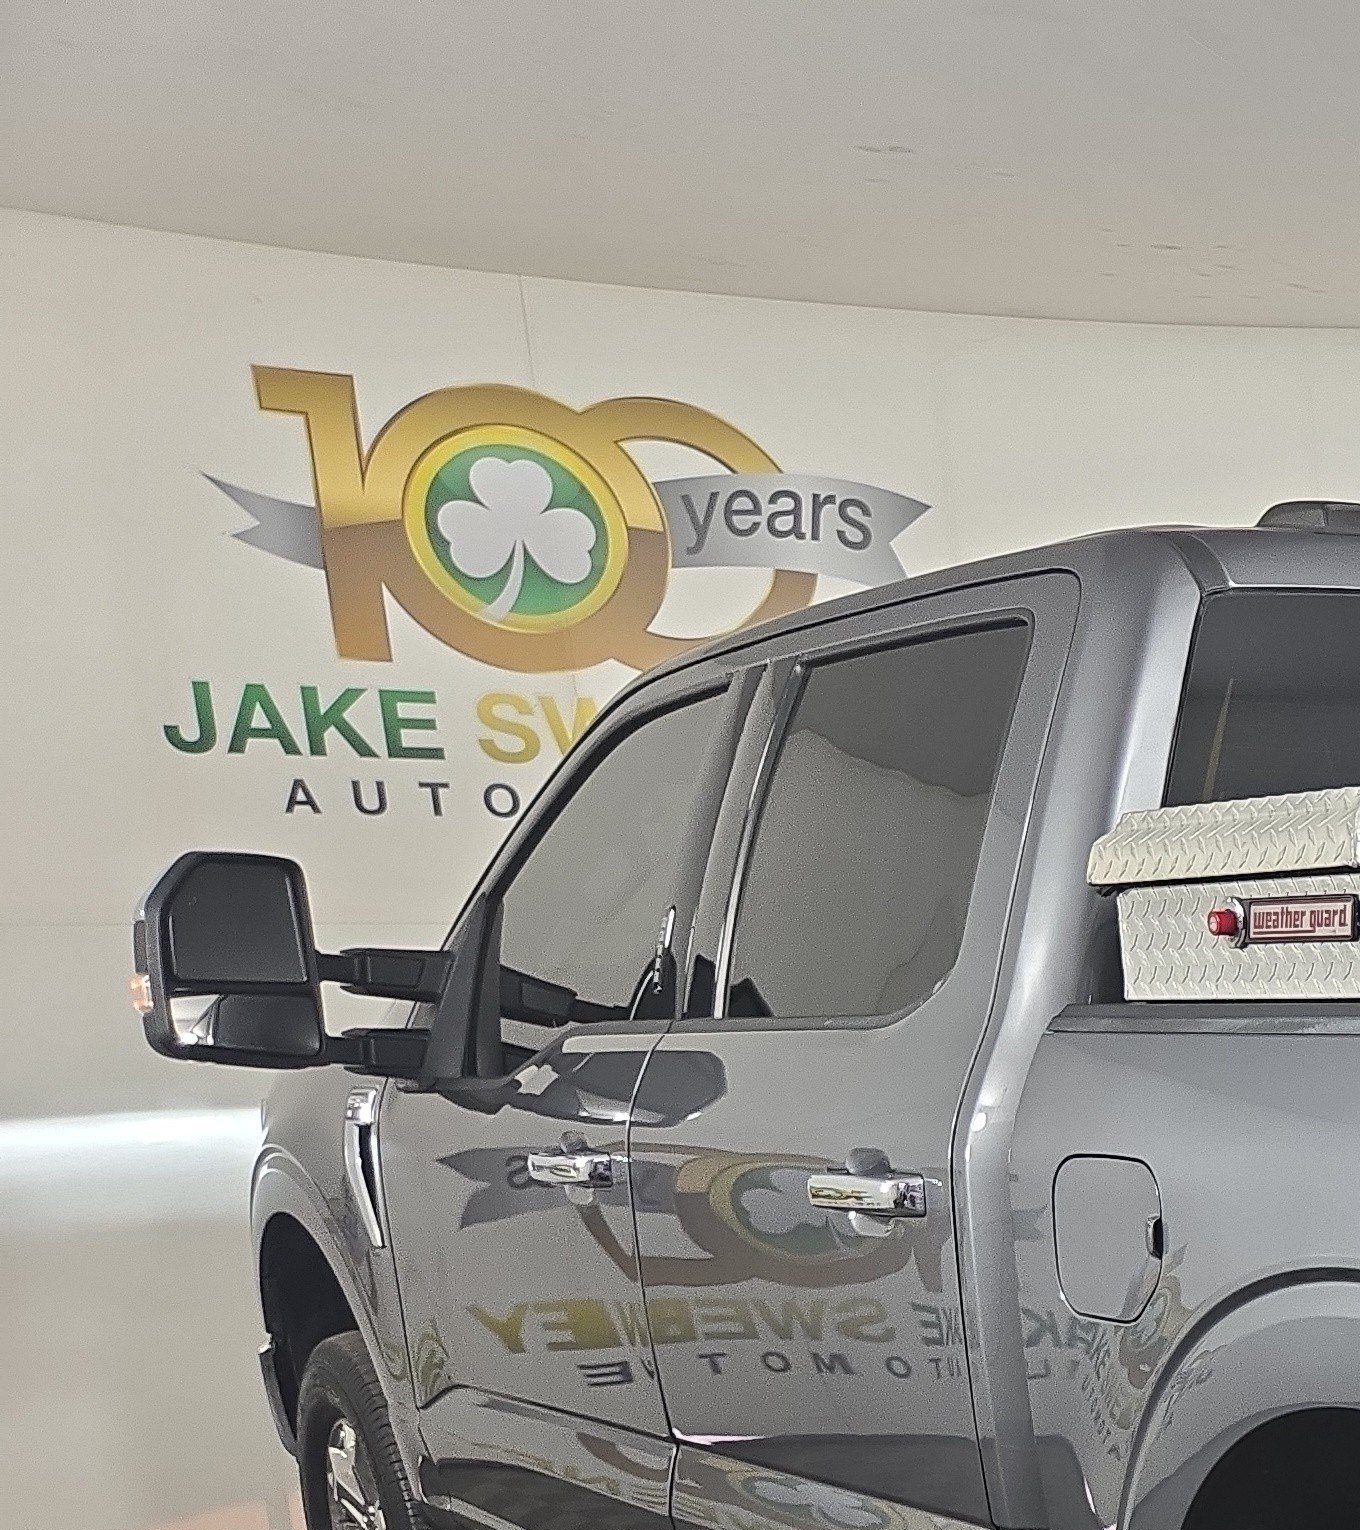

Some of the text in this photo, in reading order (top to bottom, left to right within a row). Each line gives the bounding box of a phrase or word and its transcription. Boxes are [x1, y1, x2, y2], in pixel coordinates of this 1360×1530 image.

[250, 364, 818, 674] 100
[681, 485, 875, 553] years
[162, 680, 447, 761] JAKE
[1253, 904, 1348, 932] weather guard
